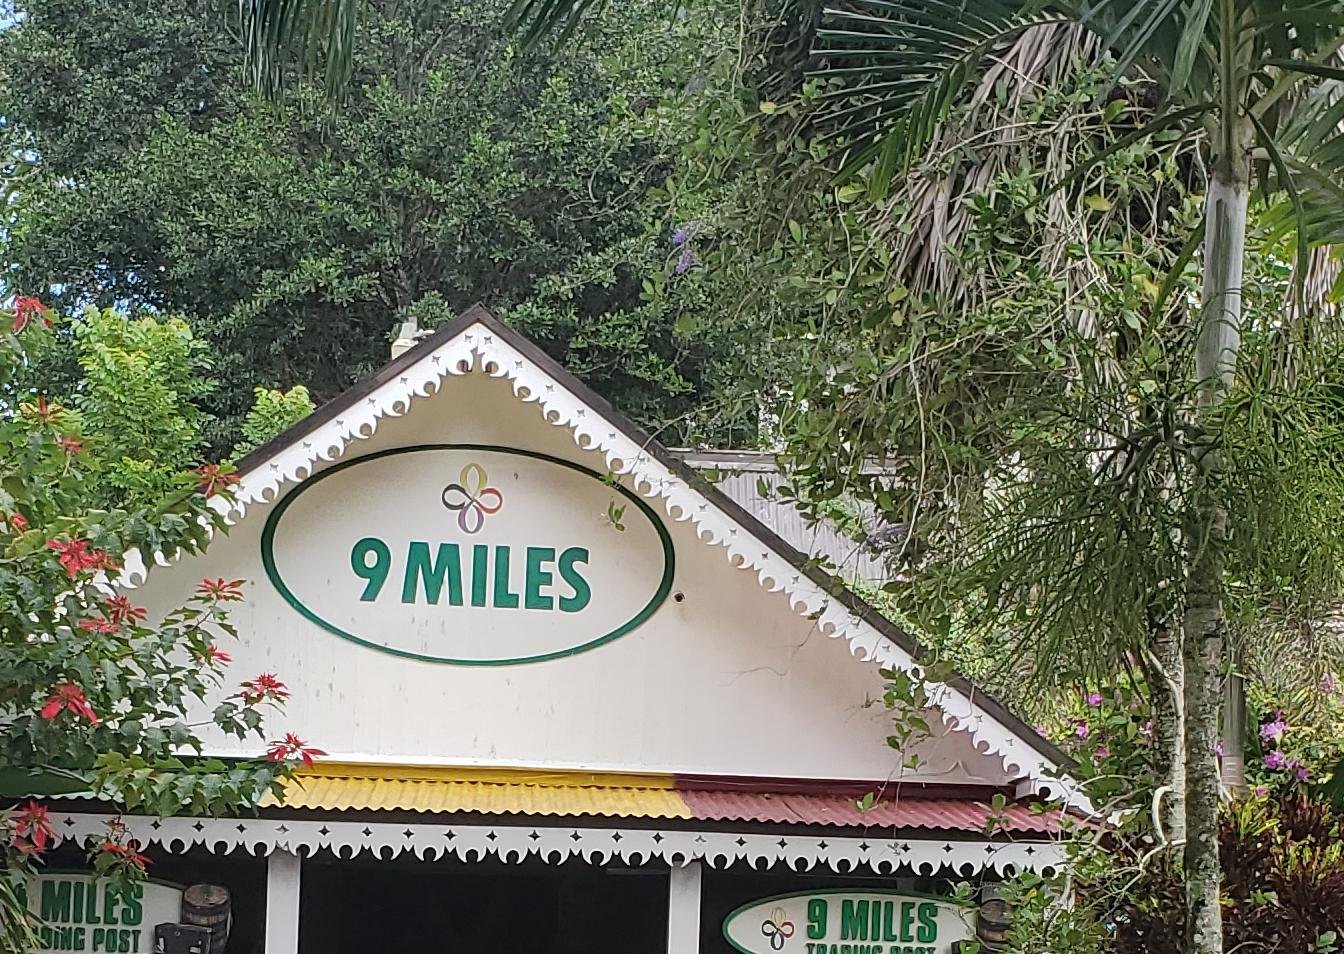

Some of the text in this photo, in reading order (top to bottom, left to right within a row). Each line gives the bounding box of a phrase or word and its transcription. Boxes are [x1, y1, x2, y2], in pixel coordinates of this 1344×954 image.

[351, 537, 592, 613] 9 MILES
[41, 880, 143, 925] MILES
[807, 898, 938, 943] 9 MILES
[93, 927, 142, 953] POST
